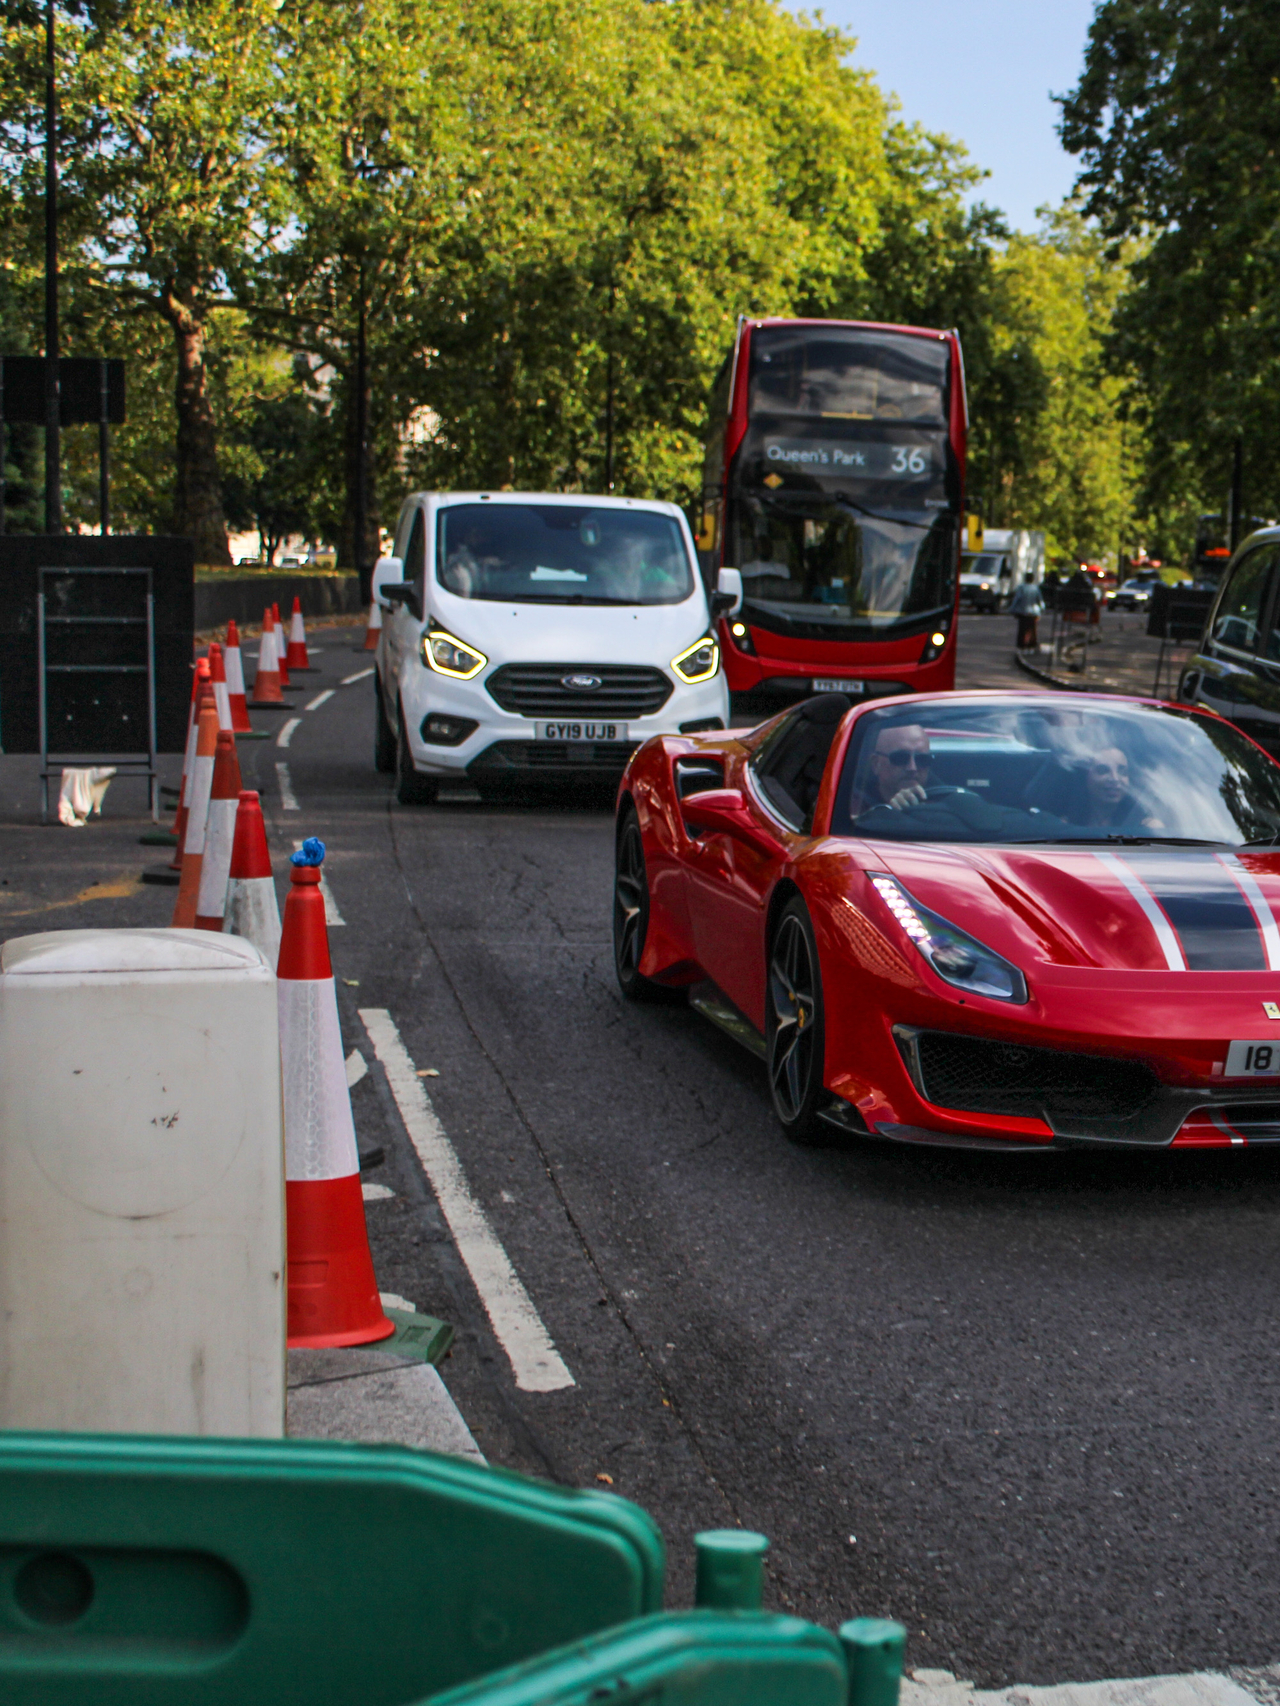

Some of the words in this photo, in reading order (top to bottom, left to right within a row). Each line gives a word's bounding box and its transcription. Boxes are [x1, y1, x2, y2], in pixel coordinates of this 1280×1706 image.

[767, 445, 829, 464] Queen's
[833, 449, 865, 466] Park
[891, 446, 925, 473] 36
[546, 724, 581, 739] GY19
[585, 725, 616, 739] UJB
[1245, 1046, 1273, 1070] 18
